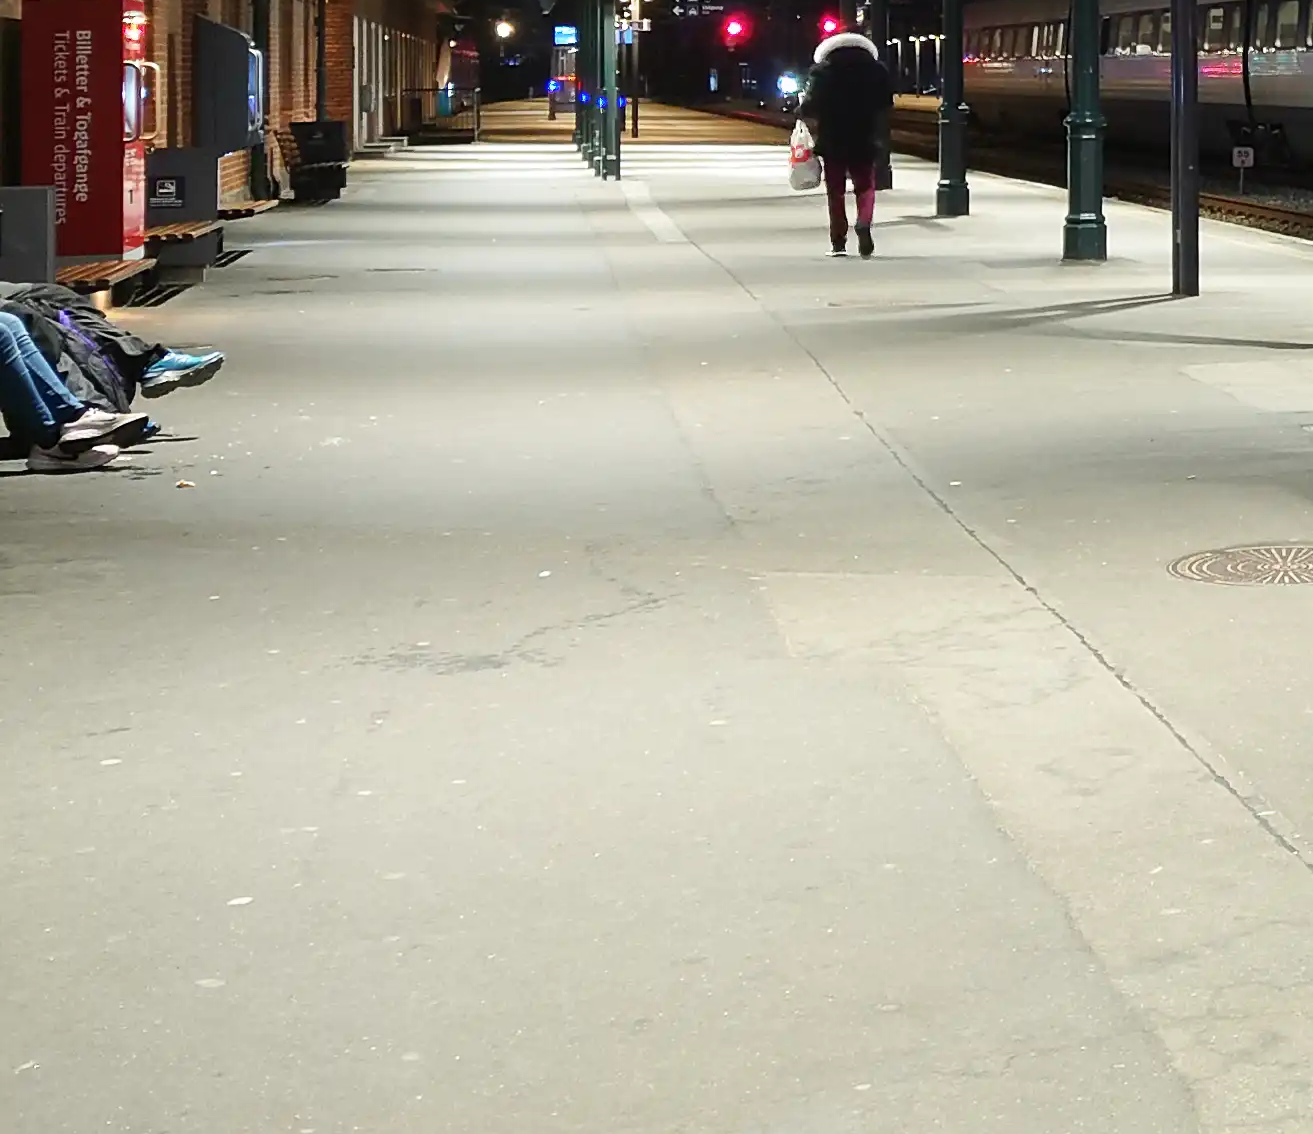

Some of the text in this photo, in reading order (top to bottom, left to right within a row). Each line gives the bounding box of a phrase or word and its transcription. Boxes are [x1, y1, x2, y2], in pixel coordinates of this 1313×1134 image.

[50, 30, 71, 225] Tickets & Train departures
[72, 29, 93, 202] Billetter & Togafgange
